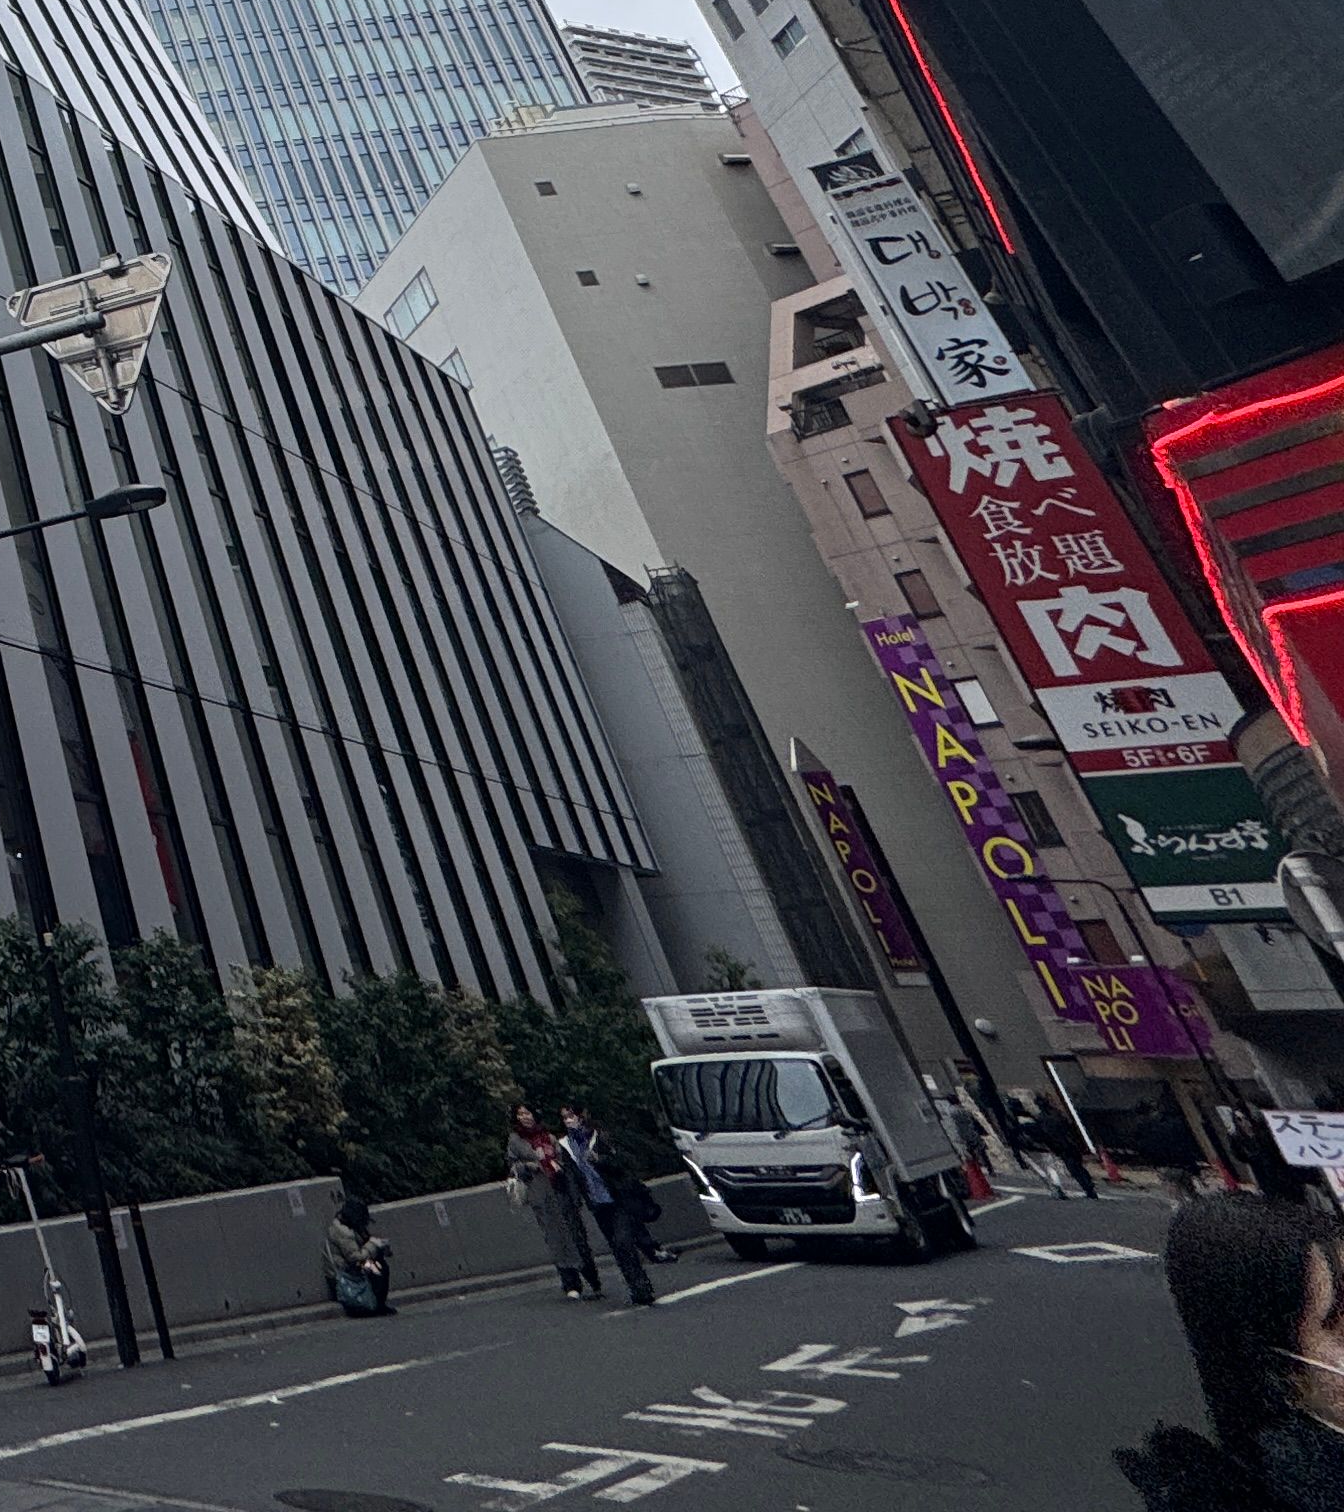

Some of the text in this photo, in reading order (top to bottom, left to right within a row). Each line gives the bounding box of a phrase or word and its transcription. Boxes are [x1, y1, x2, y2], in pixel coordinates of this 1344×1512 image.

[875, 627, 915, 648] Hotel
[1082, 712, 1223, 739] SEIKO-EN
[891, 668, 1068, 1010] NAPOLI
[807, 782, 890, 955] NAPOLI
[1210, 887, 1246, 906] B1
